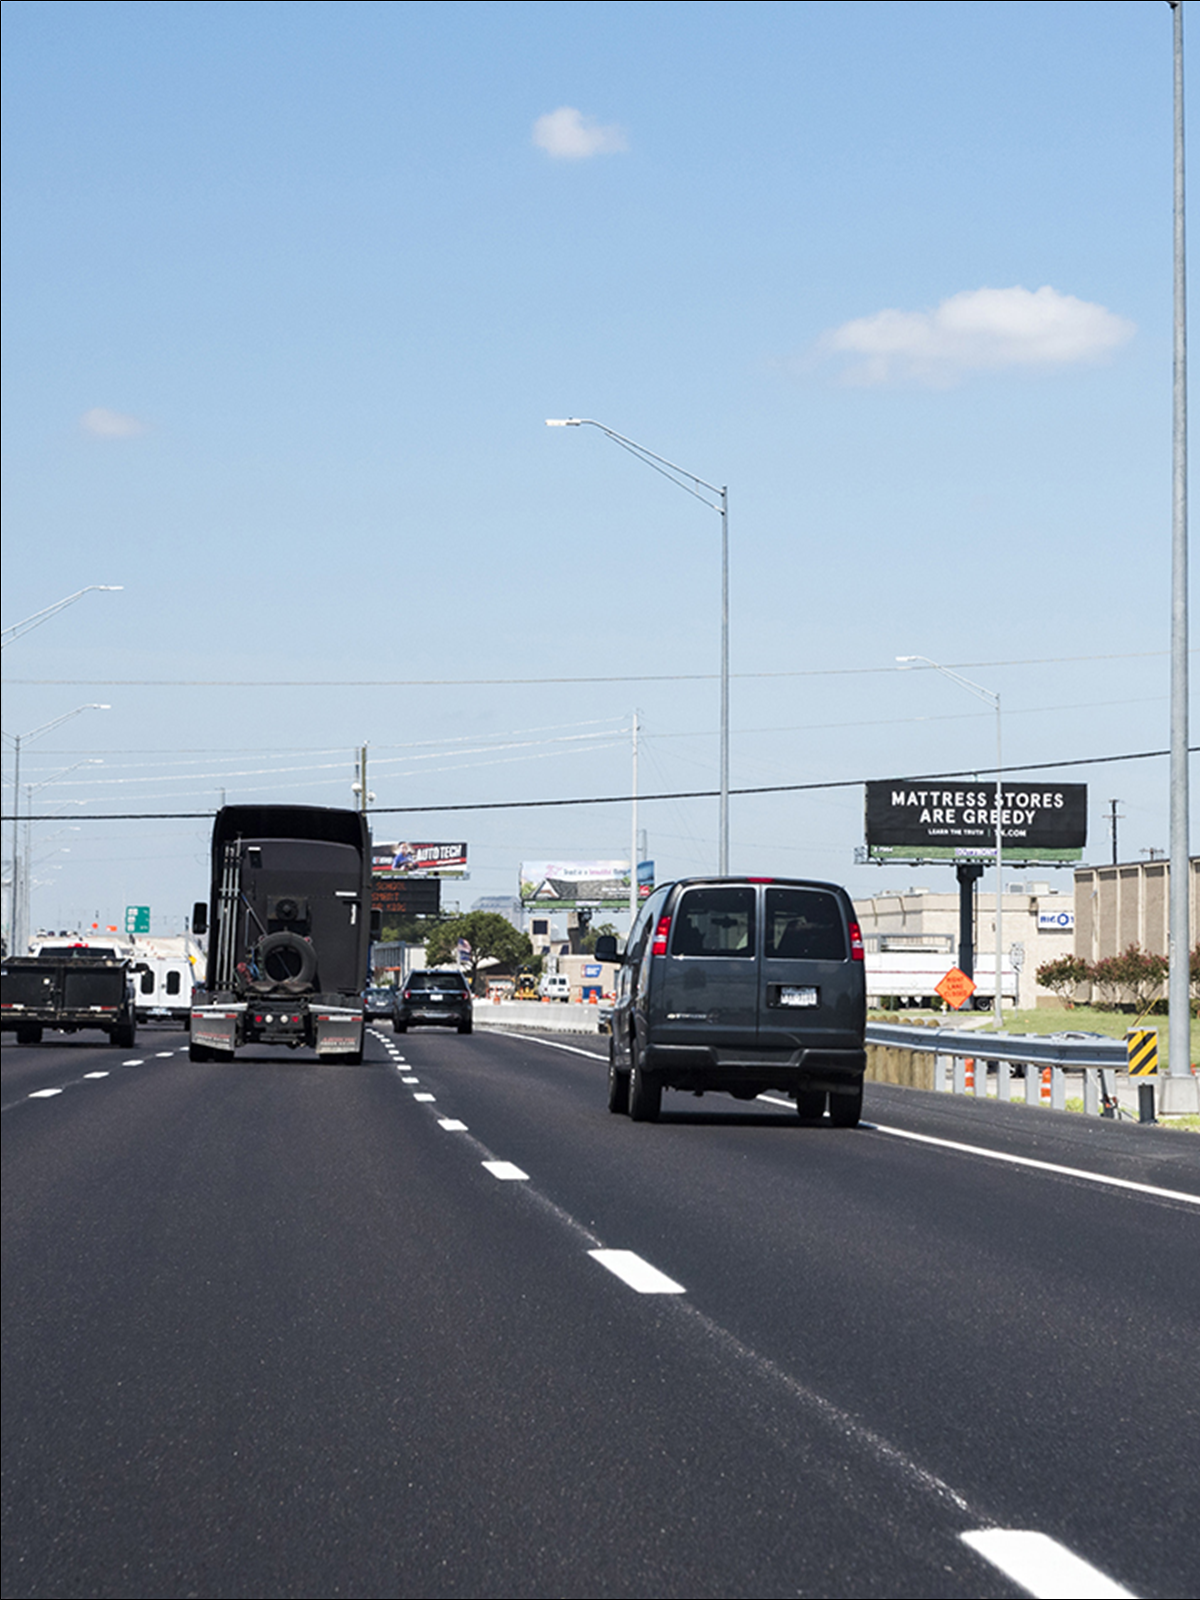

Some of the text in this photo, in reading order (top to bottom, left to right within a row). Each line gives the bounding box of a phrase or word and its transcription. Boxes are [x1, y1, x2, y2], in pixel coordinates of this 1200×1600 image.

[892, 791, 1064, 808] MATTRESS STORES
[919, 809, 1036, 825] ARE GREEDY
[416, 845, 462, 860] AUTO TECH
